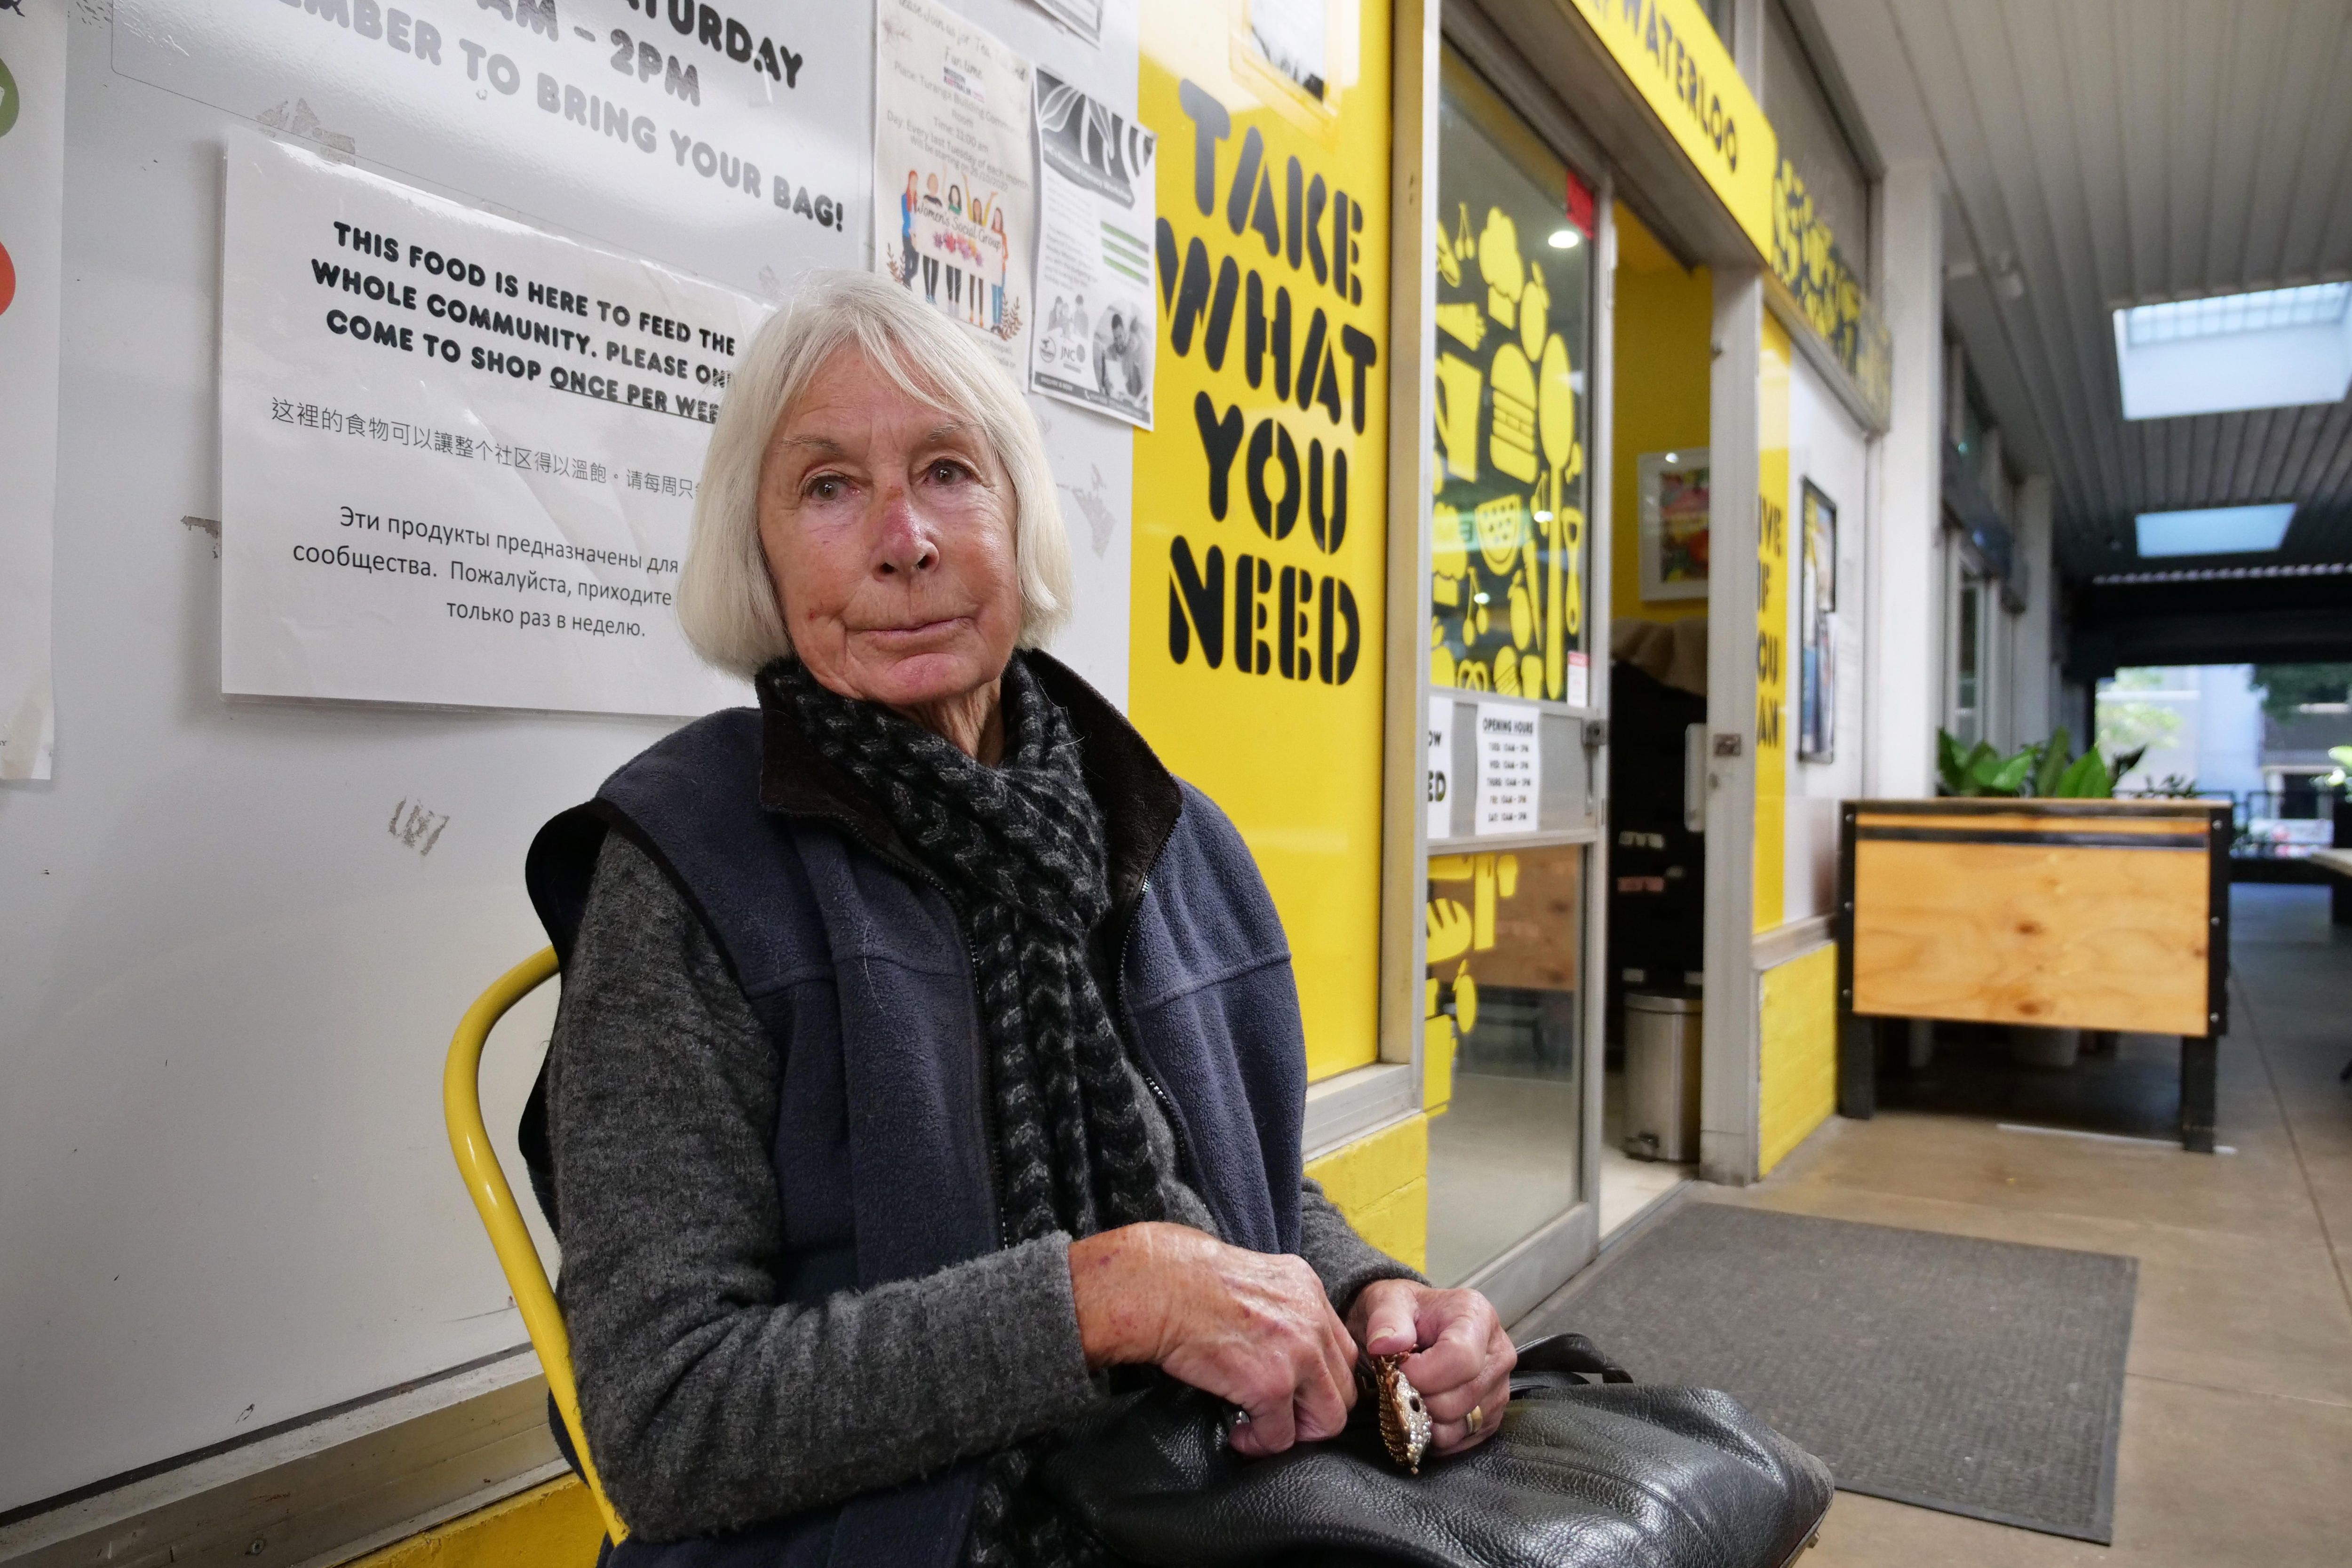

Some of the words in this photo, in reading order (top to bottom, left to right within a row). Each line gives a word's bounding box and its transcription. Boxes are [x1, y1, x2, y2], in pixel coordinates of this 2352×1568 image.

[611, 29, 700, 107] 2PM
[459, 38, 520, 95] TO
[538, 72, 657, 153] BRING
[670, 129, 761, 199] YOUR
[774, 175, 843, 232] BAG!
[952, 215, 976, 239] Social
[1179, 79, 1363, 307] TAKE
[311, 259, 416, 310] WHOLE
[427, 293, 596, 357] COMMUNITY.
[606, 341, 688, 379] PLEASE
[334, 221, 399, 263] THIS
[410, 245, 485, 287] FOOD
[495, 271, 518, 297] IS
[528, 281, 588, 317] HERE
[597, 300, 630, 326] TO
[639, 312, 691, 342] FEED
[699, 328, 735, 357] THE
[1156, 216, 1376, 436] WHAT
[326, 309, 413, 352] COME
[423, 334, 461, 363] TO
[471, 346, 540, 381] SHOP
[549, 366, 618, 400] ONCE
[627, 382, 667, 413] PER
[1194, 390, 1347, 555] YOU
[293, 544, 437, 577] сообщества.
[451, 561, 572, 597] Пожалуйста,
[578, 582, 672, 606] приходите
[340, 506, 379, 532] Эти
[388, 517, 489, 547] продукты
[497, 533, 642, 569] предназначены
[647, 557, 678, 576] для
[447, 602, 514, 624] только
[520, 609, 550, 631] раз
[557, 615, 566, 629] в
[572, 617, 645, 637] неделю.
[1169, 535, 1360, 685] NEED
[1483, 717, 1512, 732] OPENING
[1514, 720, 1534, 734] HOURS
